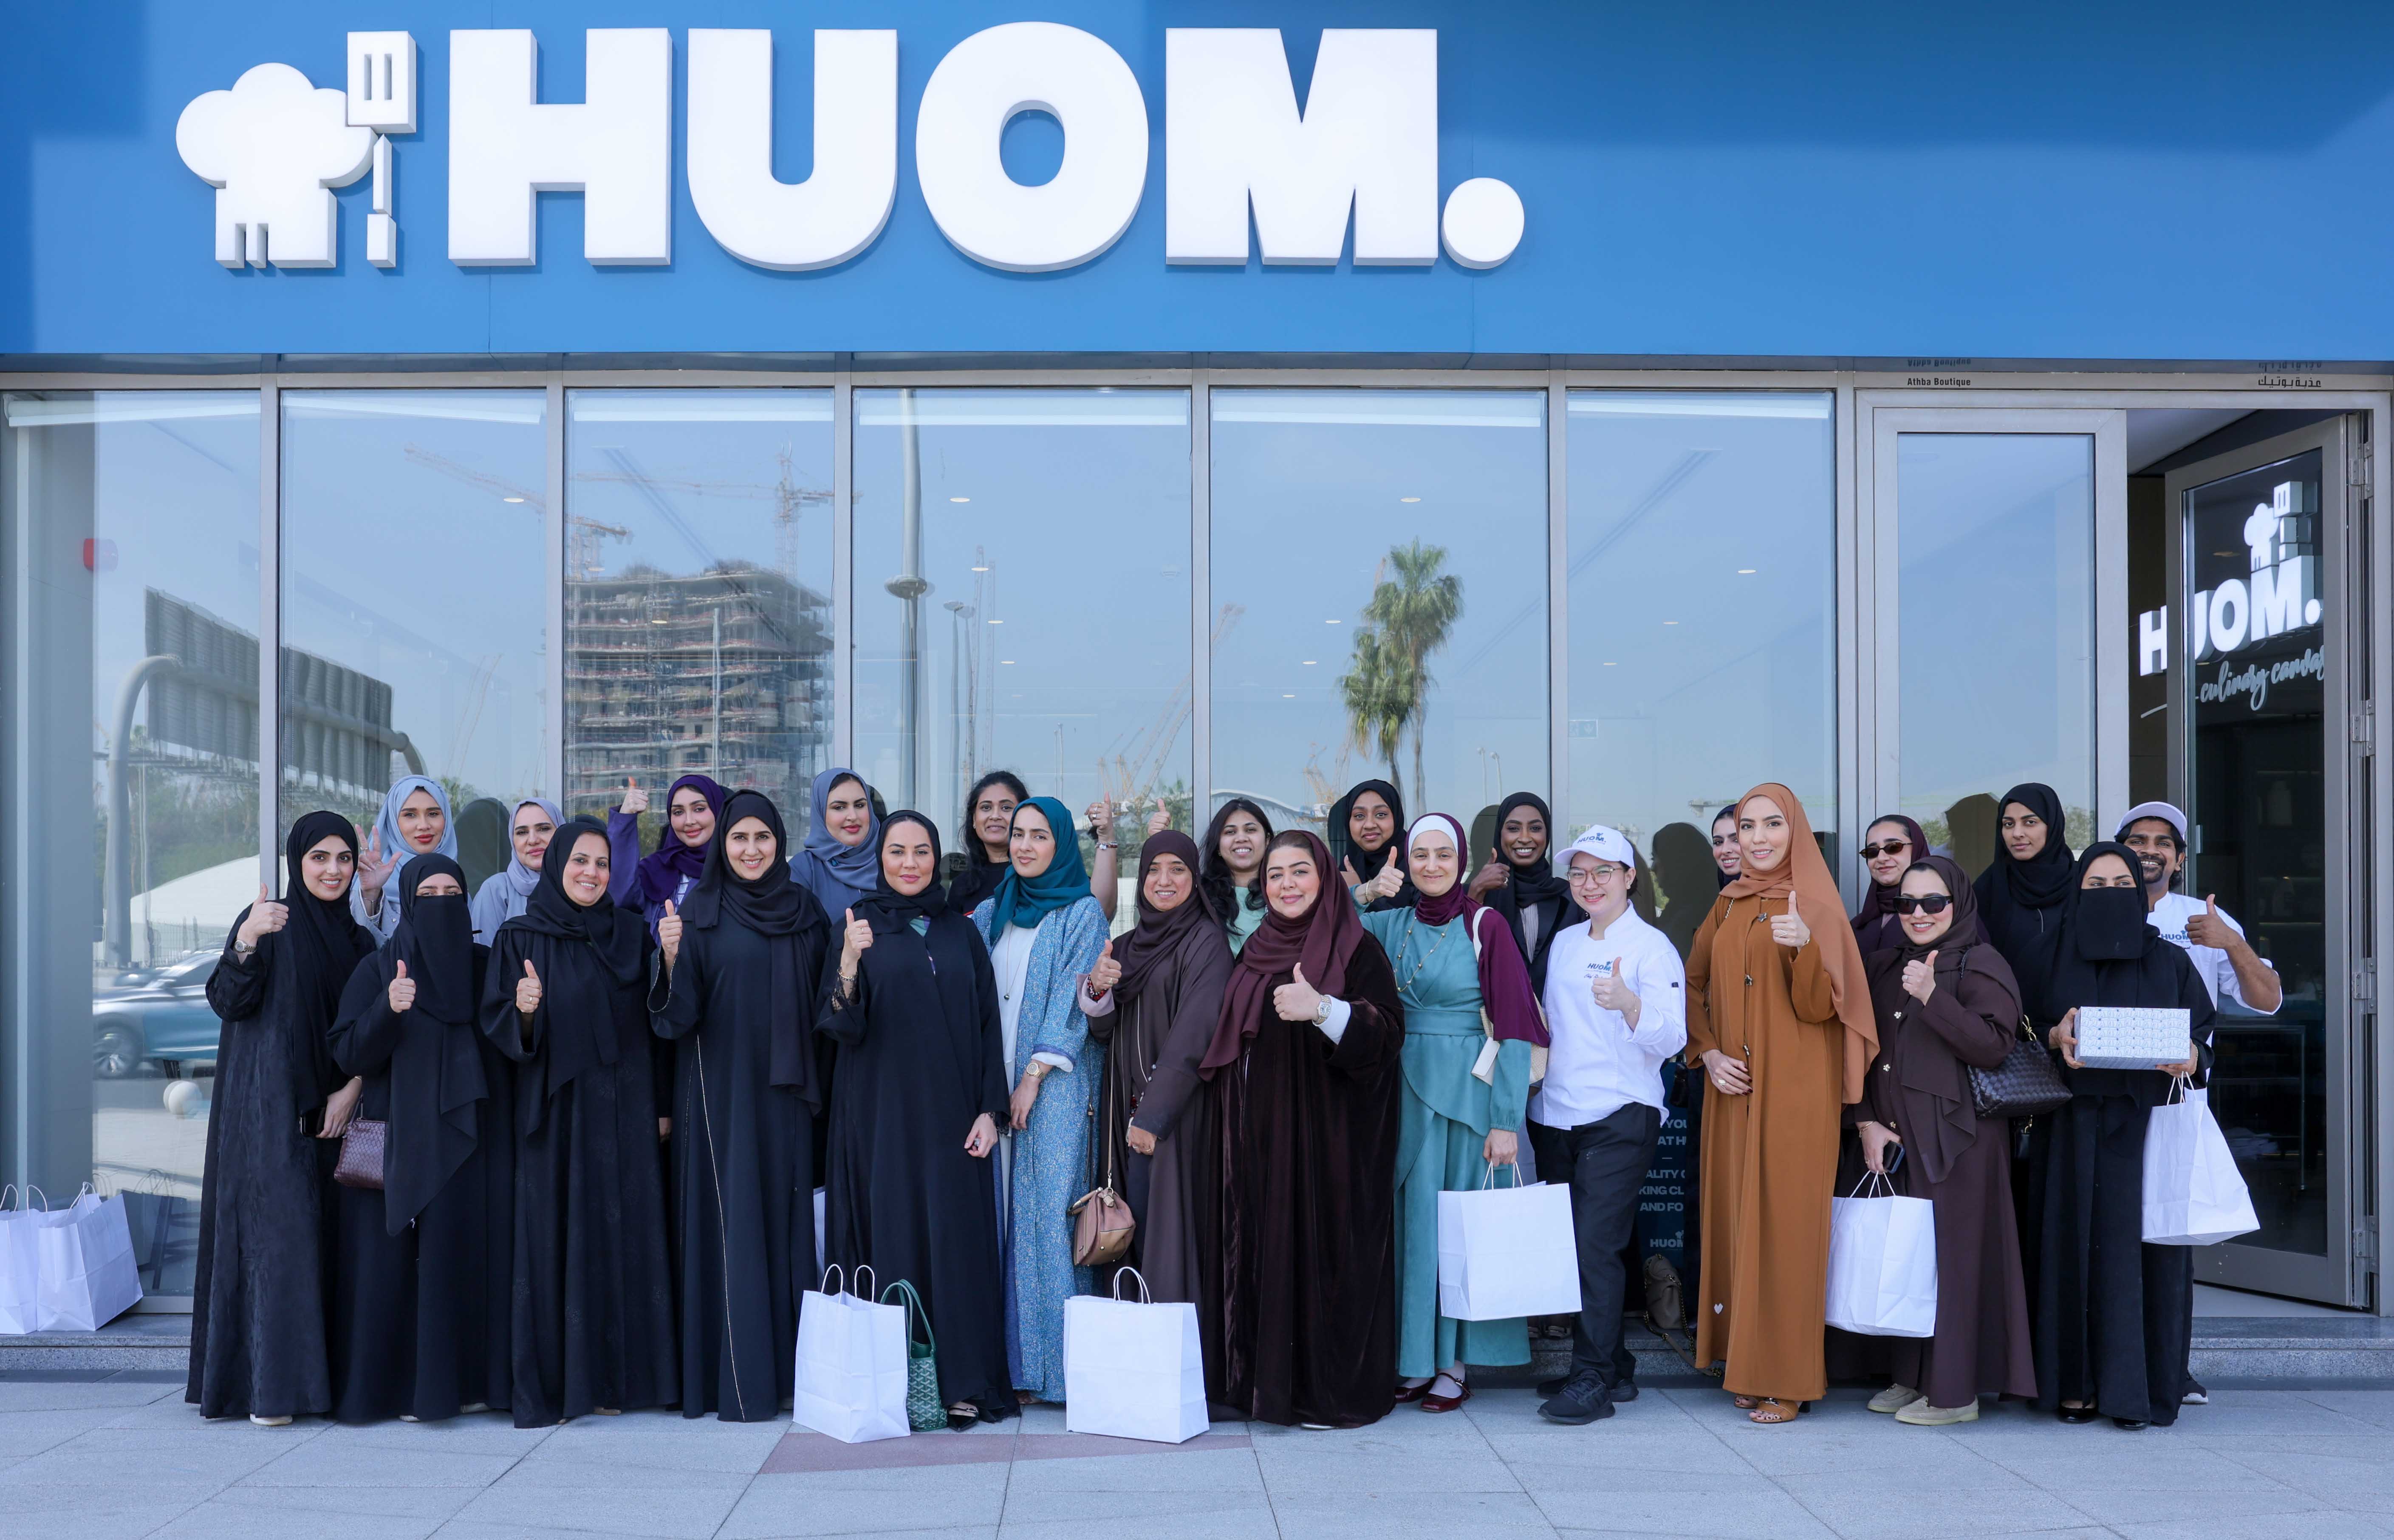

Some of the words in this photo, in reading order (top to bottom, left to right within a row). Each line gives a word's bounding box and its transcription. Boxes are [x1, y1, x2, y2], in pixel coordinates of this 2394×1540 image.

[448, 21, 1525, 272] HUOM.
[1907, 378, 1931, 386] Athba
[1934, 378, 1971, 387] Boutique
[2258, 375, 2293, 388] بوتيك
[2295, 377, 2321, 389] عذبة
[1646, 1169, 1679, 1179] ALITY
[1639, 1186, 1667, 1195] KING
[1669, 1186, 1685, 1195] CL
[1640, 1202, 1666, 1211] AND
[1667, 1202, 1684, 1211] FO
